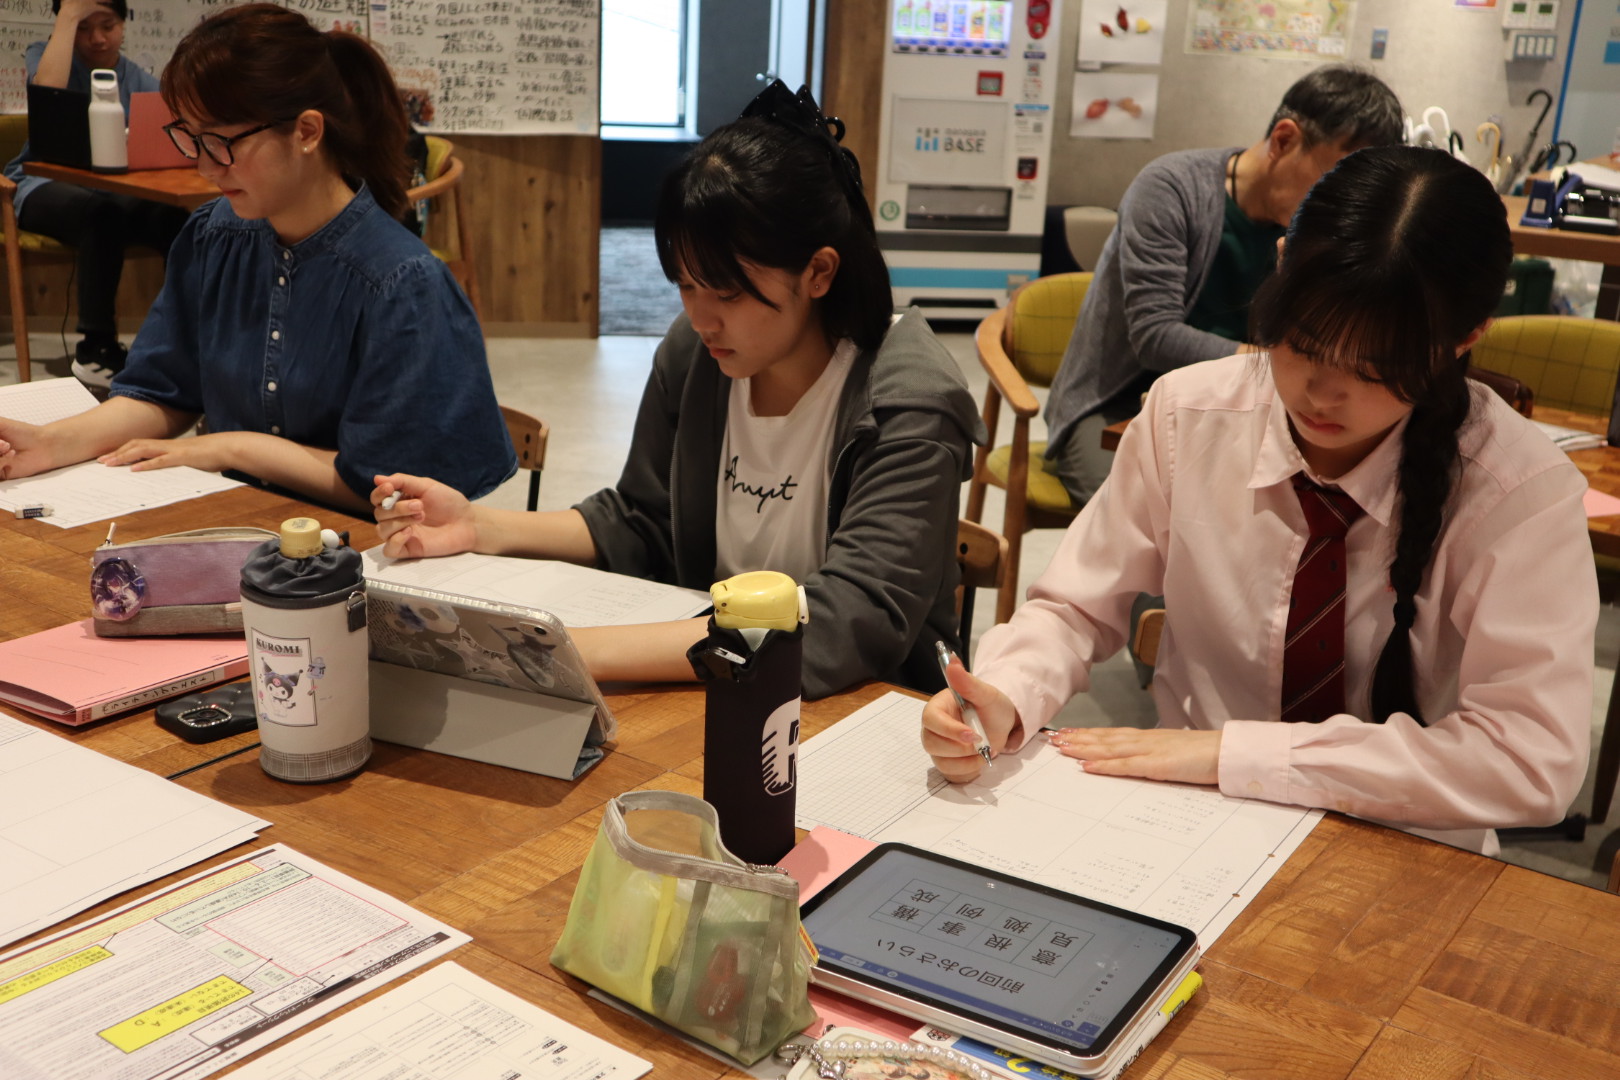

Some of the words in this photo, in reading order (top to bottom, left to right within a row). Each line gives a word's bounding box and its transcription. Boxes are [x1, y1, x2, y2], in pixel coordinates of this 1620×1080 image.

[944, 137, 985, 152] BASE
[255, 638, 300, 654] KUROMI
[891, 888, 941, 922] 構成
[940, 903, 986, 937] 事例
[984, 916, 1033, 952] 根拠
[1033, 930, 1080, 967] 意見
[875, 938, 1025, 996] 前回のおさらい
